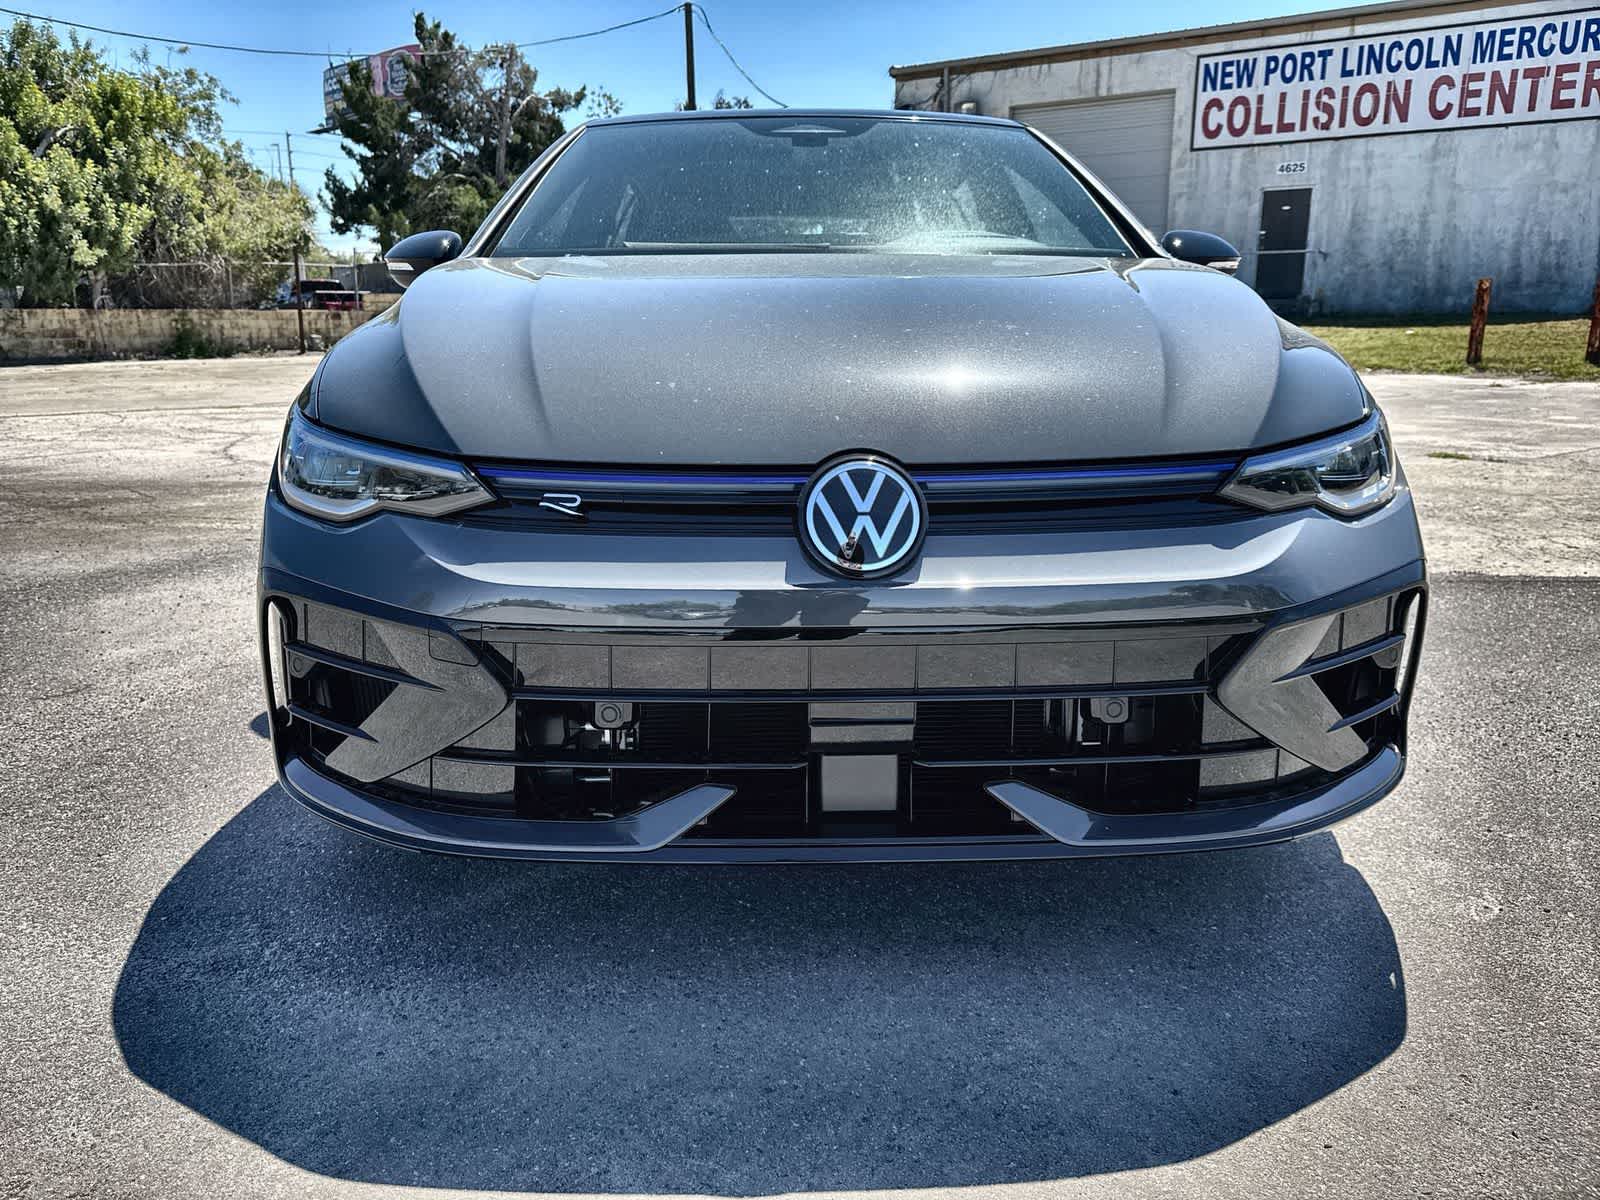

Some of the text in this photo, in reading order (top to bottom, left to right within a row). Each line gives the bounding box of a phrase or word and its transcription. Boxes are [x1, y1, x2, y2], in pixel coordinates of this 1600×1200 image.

[1202, 57, 1257, 92] NEW
[1263, 48, 1334, 86] PORT
[1340, 33, 1463, 78] LINCOLN
[1201, 60, 1600, 140] COLLISION CENTER
[1278, 162, 1305, 173] 4625
[539, 493, 584, 516] R
